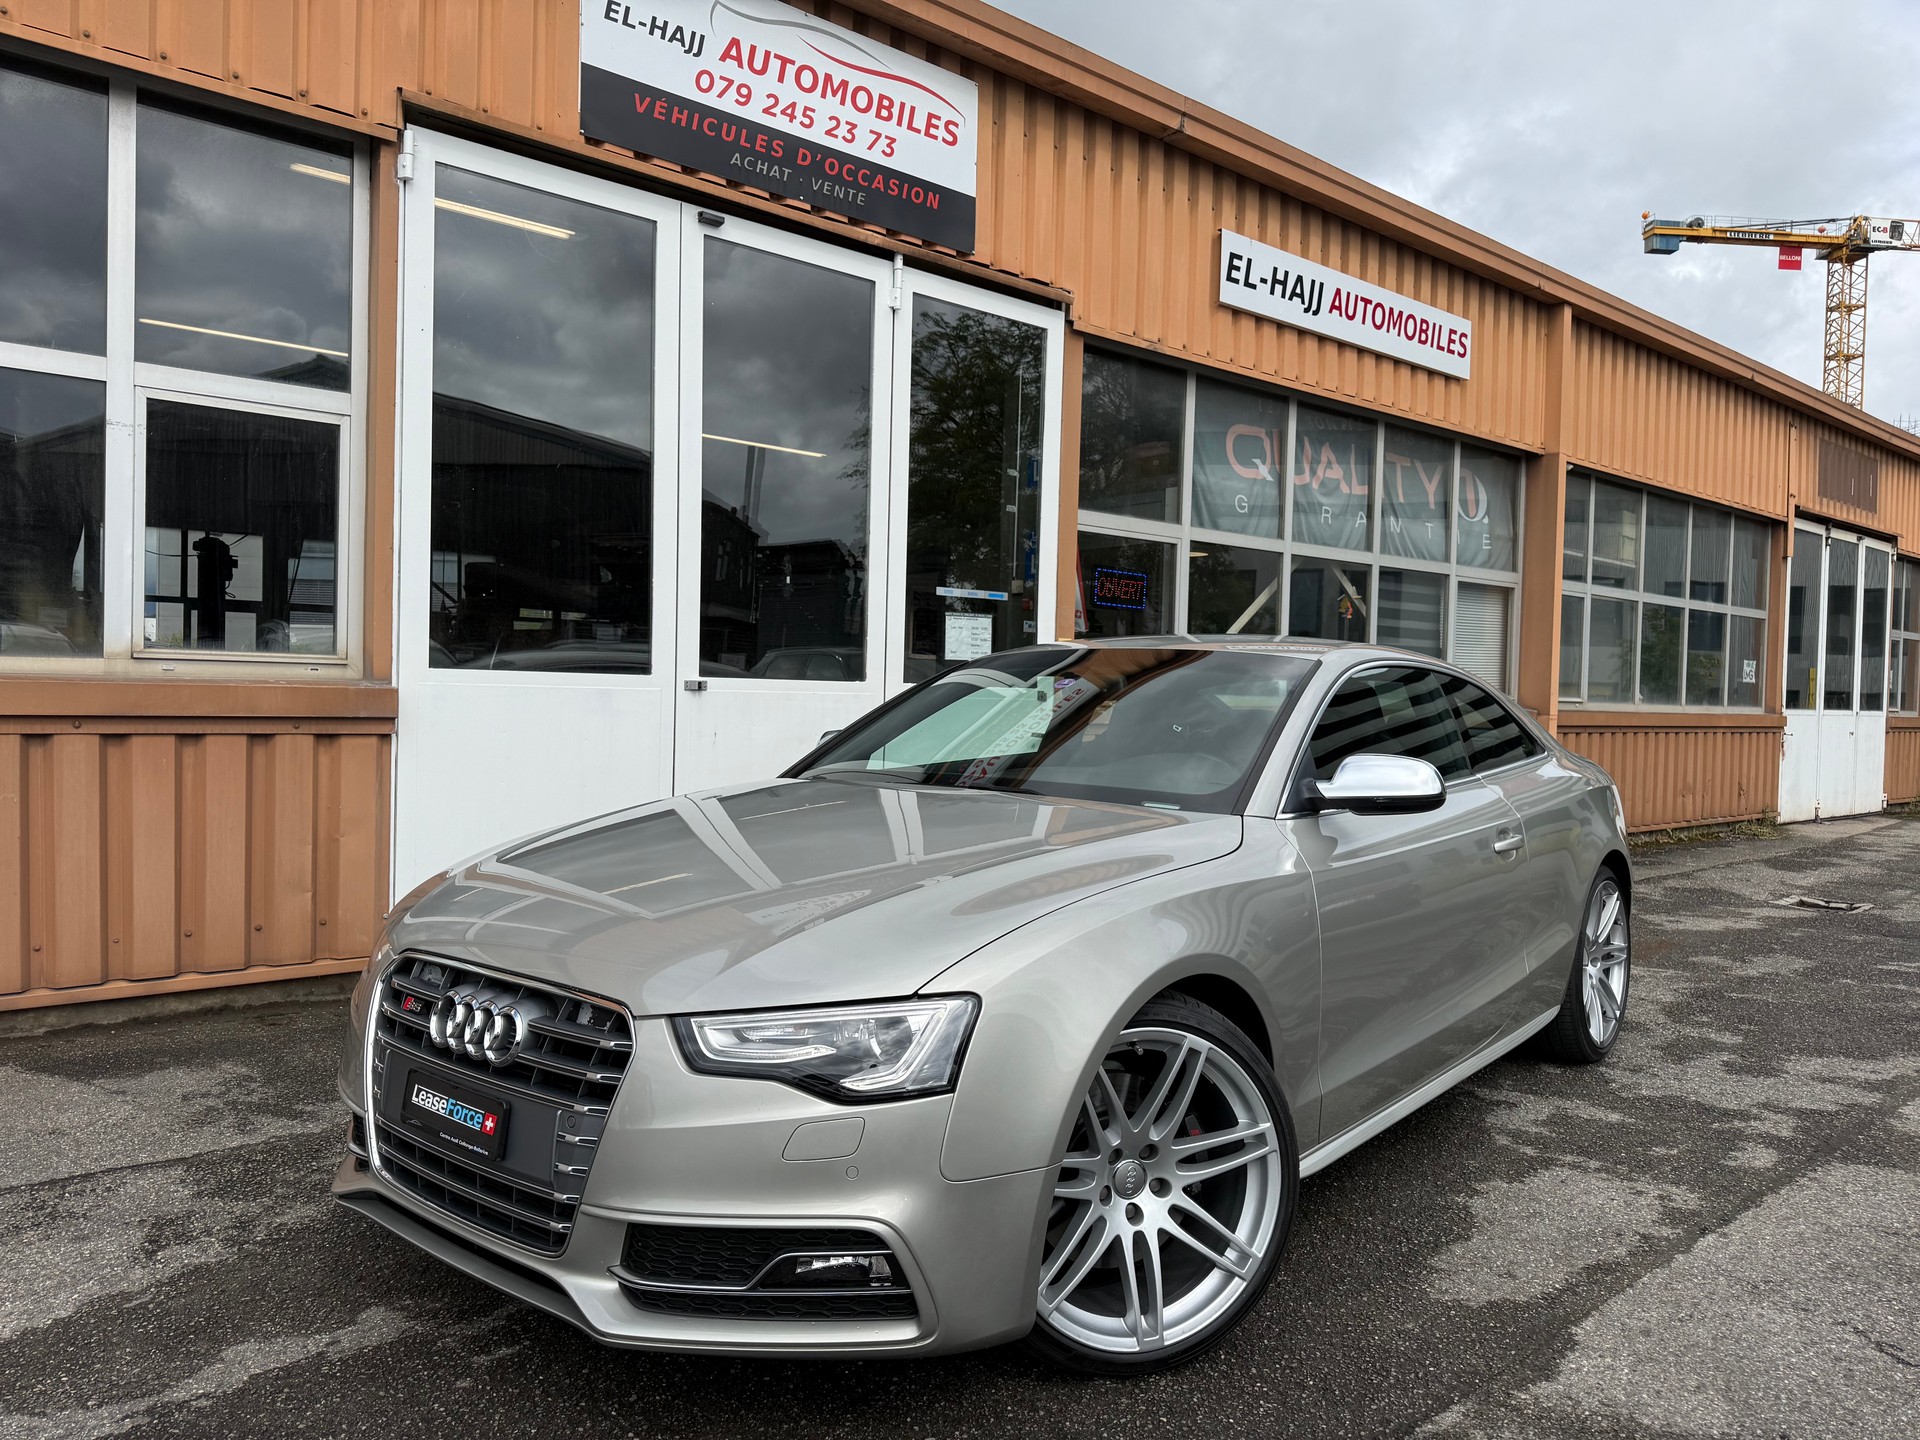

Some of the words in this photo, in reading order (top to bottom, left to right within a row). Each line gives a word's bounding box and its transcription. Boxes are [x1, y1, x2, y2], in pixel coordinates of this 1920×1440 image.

[604, 0, 706, 57] EL-HAJJ
[719, 37, 959, 147] AUTOMOBILES
[695, 69, 753, 107] 079
[762, 93, 816, 129] 245
[825, 115, 857, 145] 23
[868, 129, 897, 158] 73
[634, 93, 784, 158] VÉHICULES
[797, 147, 940, 209] D'OCCASION
[730, 152, 793, 182] ACHAT
[811, 177, 866, 206] VENTE
[1225, 252, 1325, 316] EL-HAJJ
[1329, 287, 1468, 359] AUTOMOBILES
[1226, 424, 1445, 509] QUALTY
[1234, 494, 1491, 549] GRANTIE
[412, 1084, 483, 1128] LeaseForce
